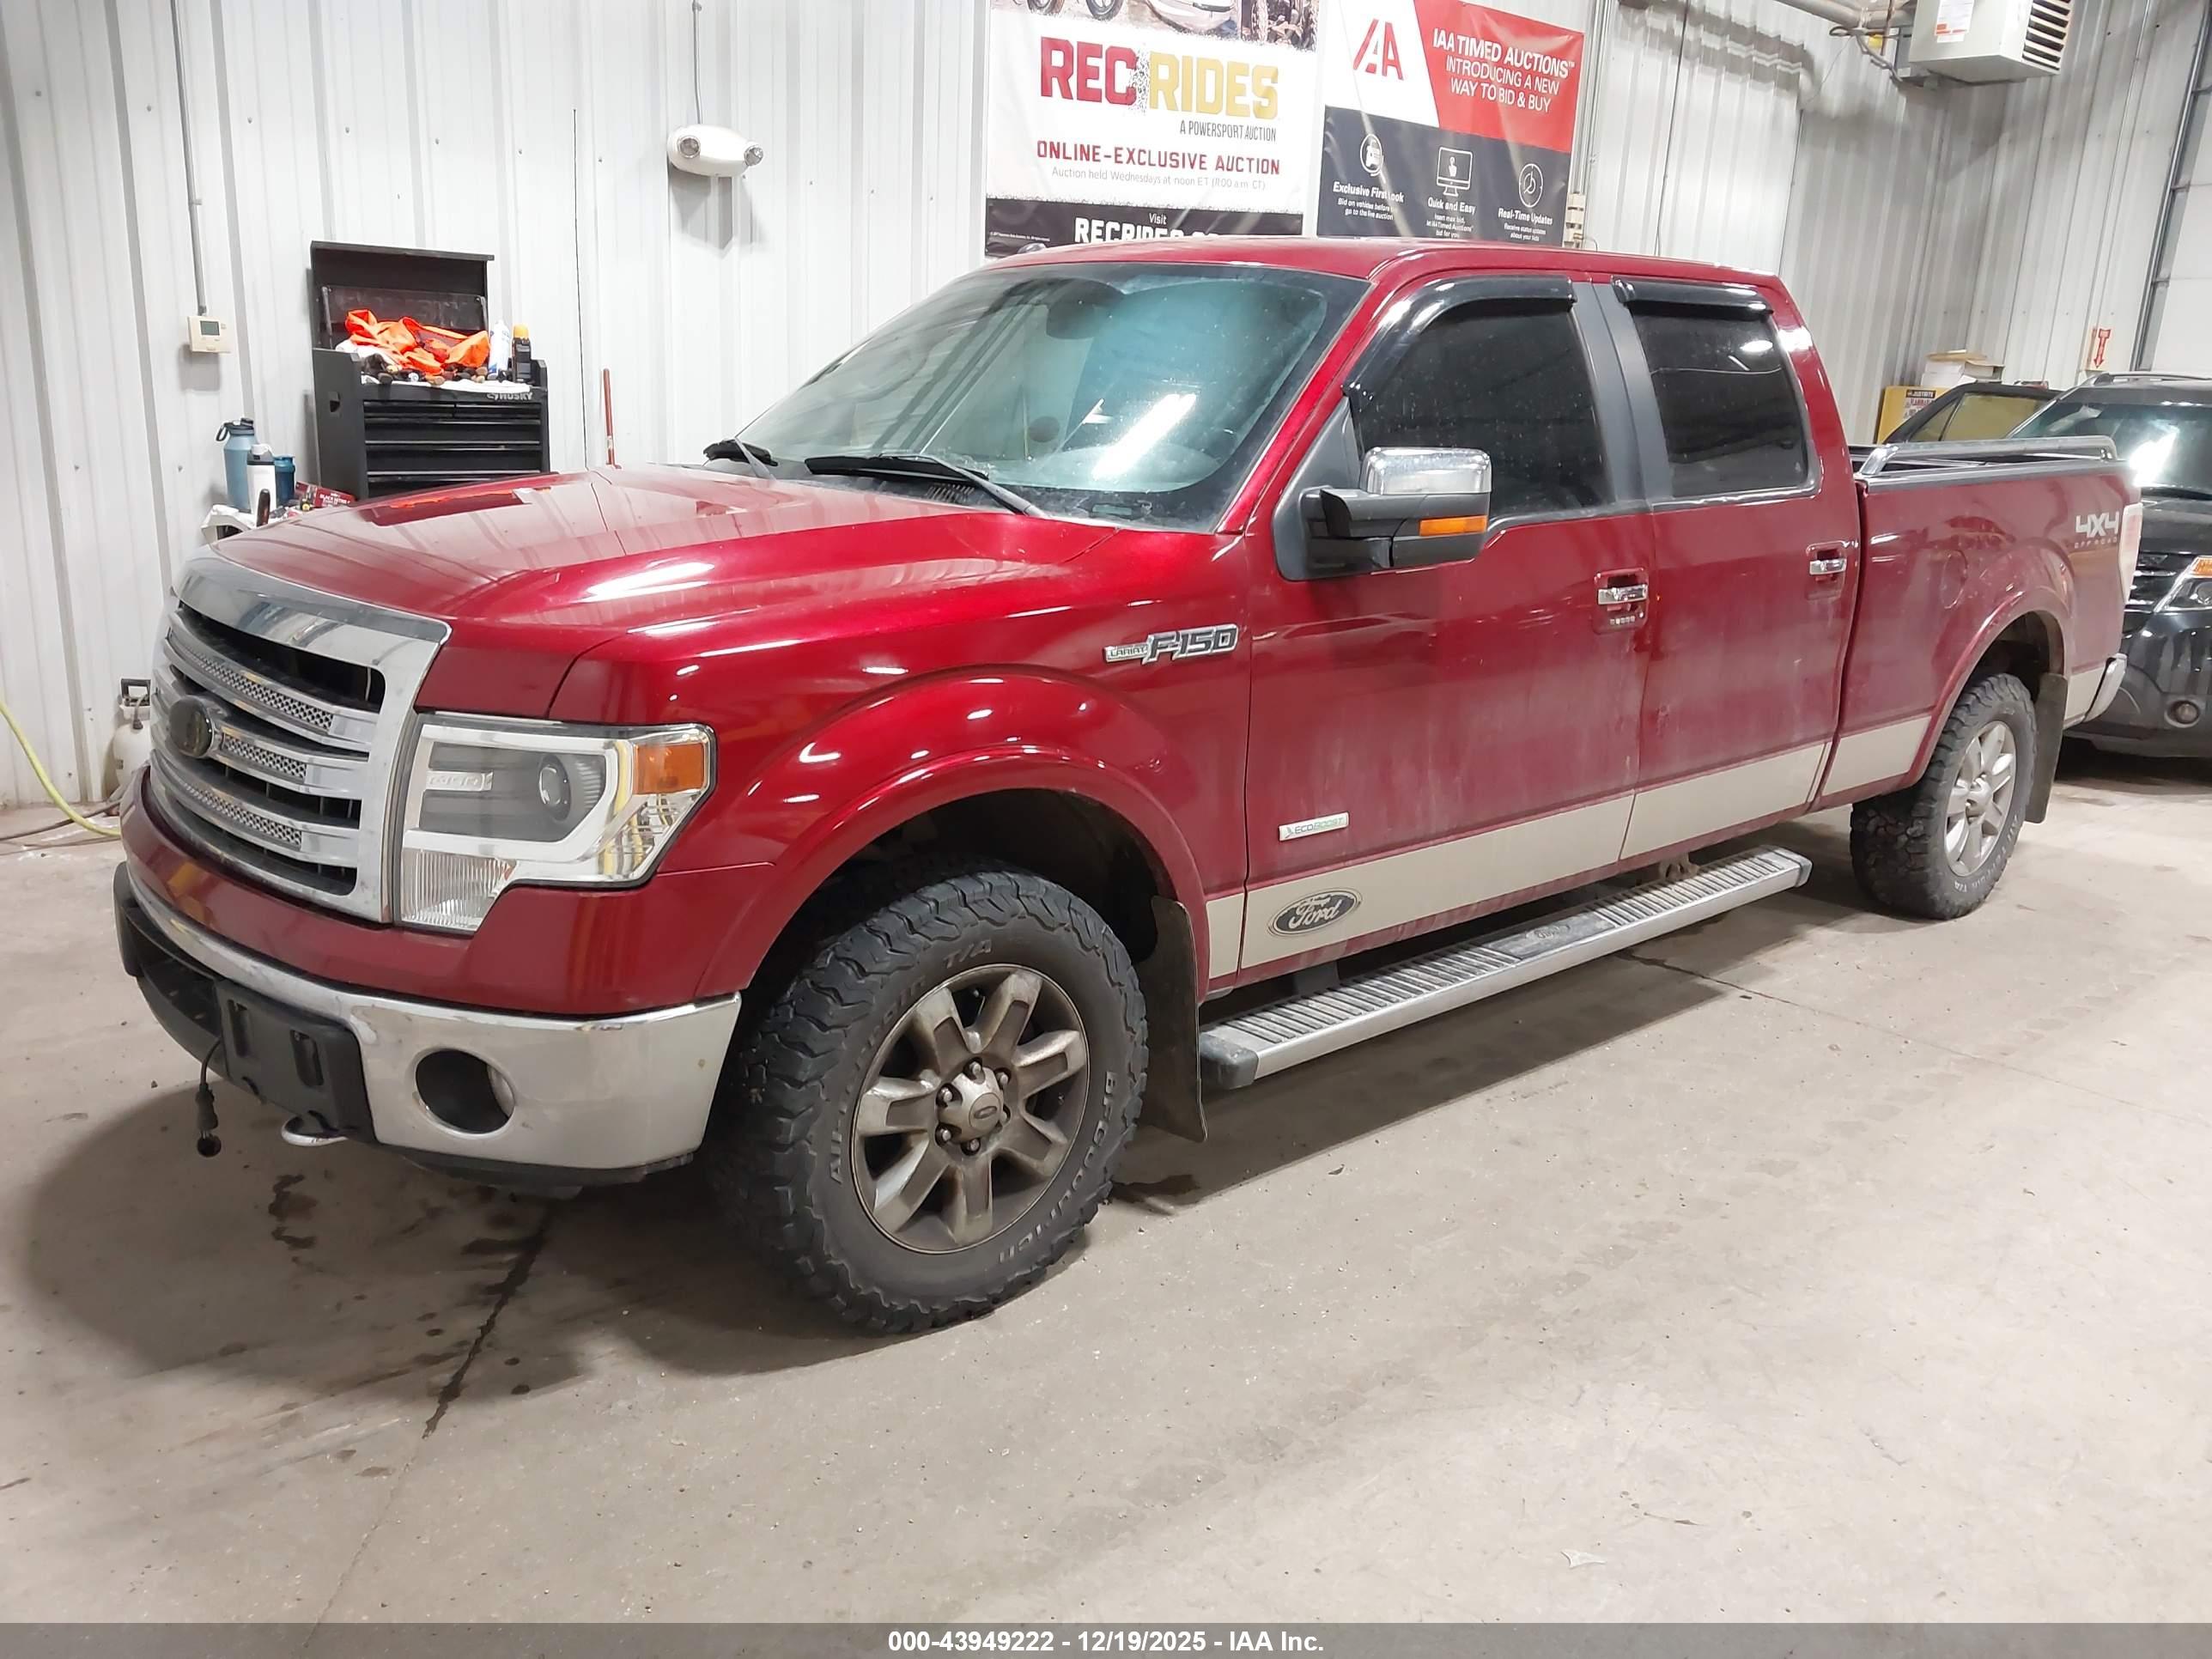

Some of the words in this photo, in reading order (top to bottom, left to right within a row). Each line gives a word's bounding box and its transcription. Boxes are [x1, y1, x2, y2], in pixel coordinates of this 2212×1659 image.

[1433, 27, 1454, 52] IAA
[1456, 34, 1502, 62] TIMED
[1041, 36, 1137, 106] REC
[1149, 51, 1279, 119] RIDES
[1446, 54, 1522, 88] INTRODUCING
[1524, 75, 1532, 90] A
[1534, 76, 1559, 96] NEW
[1450, 77, 1479, 97] WAY
[1480, 82, 1497, 100] TO
[1498, 88, 1515, 106] BID
[1517, 93, 1526, 108] &
[1528, 95, 1552, 113] BUY
[1180, 119, 1186, 135] A
[1188, 120, 1244, 139] POWERSPORT
[1244, 125, 1277, 142] AUCTION
[1036, 140, 1207, 171] ONLINE-EXCLUSIVE
[1215, 155, 1279, 175] AUCTION
[1052, 166, 1086, 179] Auction
[1088, 169, 1108, 180] held
[1111, 171, 1161, 185] Wednesdays
[1163, 176, 1171, 185] at
[1175, 177, 1194, 186] noon
[1198, 177, 1209, 186] ET
[1333, 181, 1370, 197] Exclusive
[1370, 186, 1388, 199] First
[1149, 212, 1167, 225] Visit
[1428, 197, 1443, 210] Quick
[1444, 201, 1458, 211] and
[1460, 202, 1476, 216] Easy
[1498, 207, 1530, 222] Real-Time
[1530, 212, 1553, 225] Updates
[2075, 510, 2120, 538] 4X4
[1144, 626, 1239, 663] F-150
[1288, 896, 1344, 930] Ford
